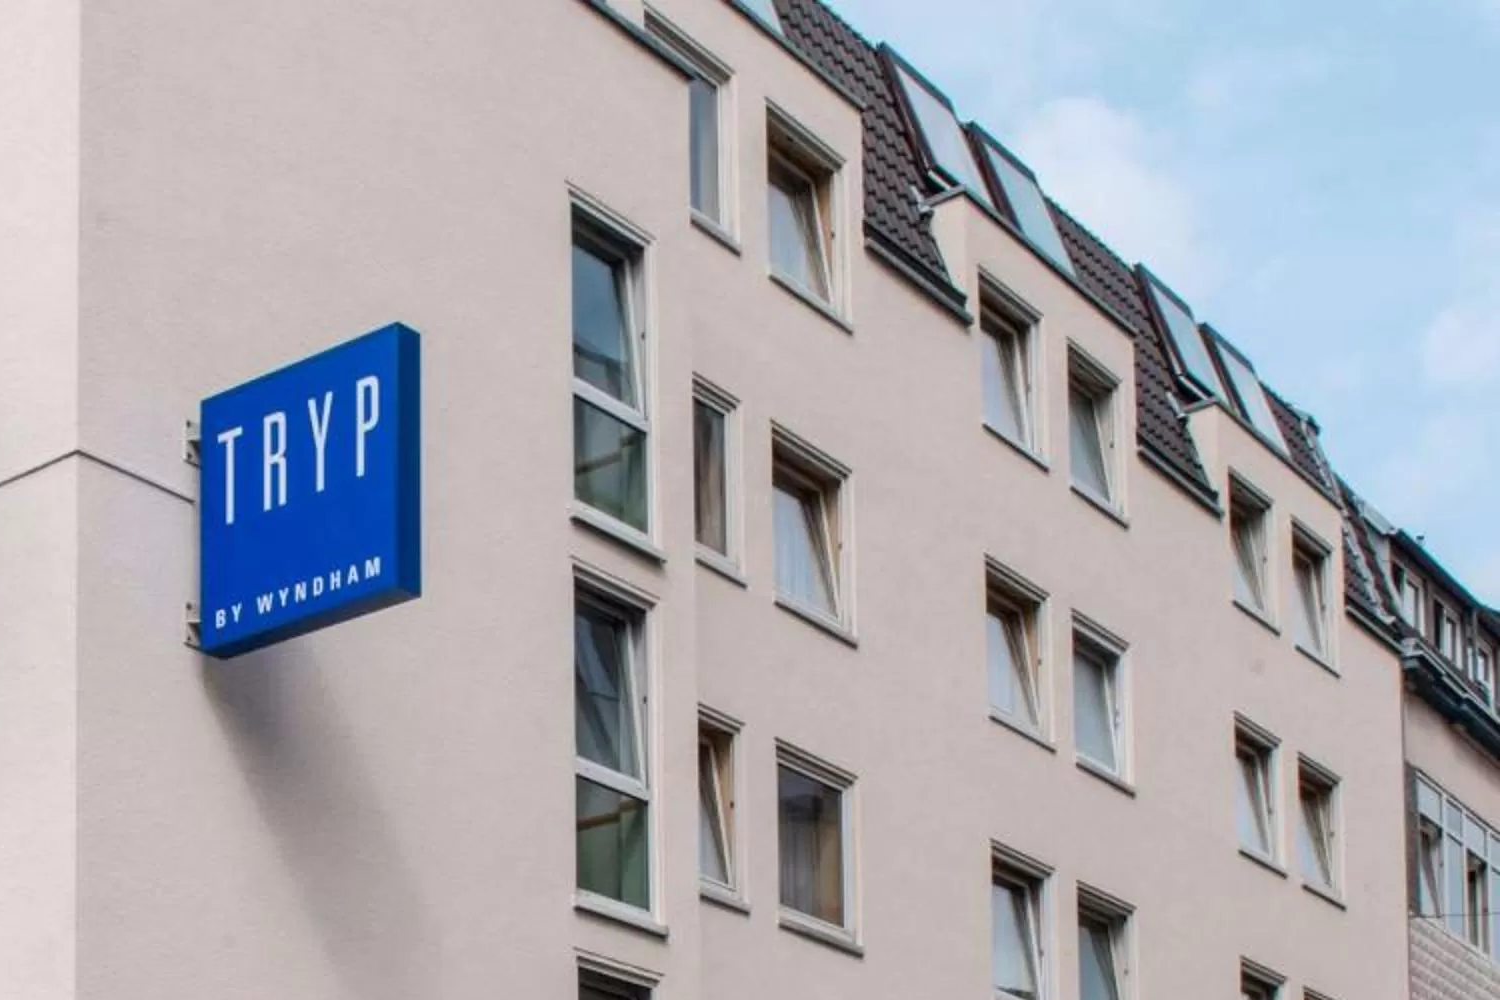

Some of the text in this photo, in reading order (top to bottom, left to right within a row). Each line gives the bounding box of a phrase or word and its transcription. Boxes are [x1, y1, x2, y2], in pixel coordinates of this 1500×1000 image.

[218, 376, 380, 525] TRYP
[215, 556, 381, 629] BY WYNDHAM
